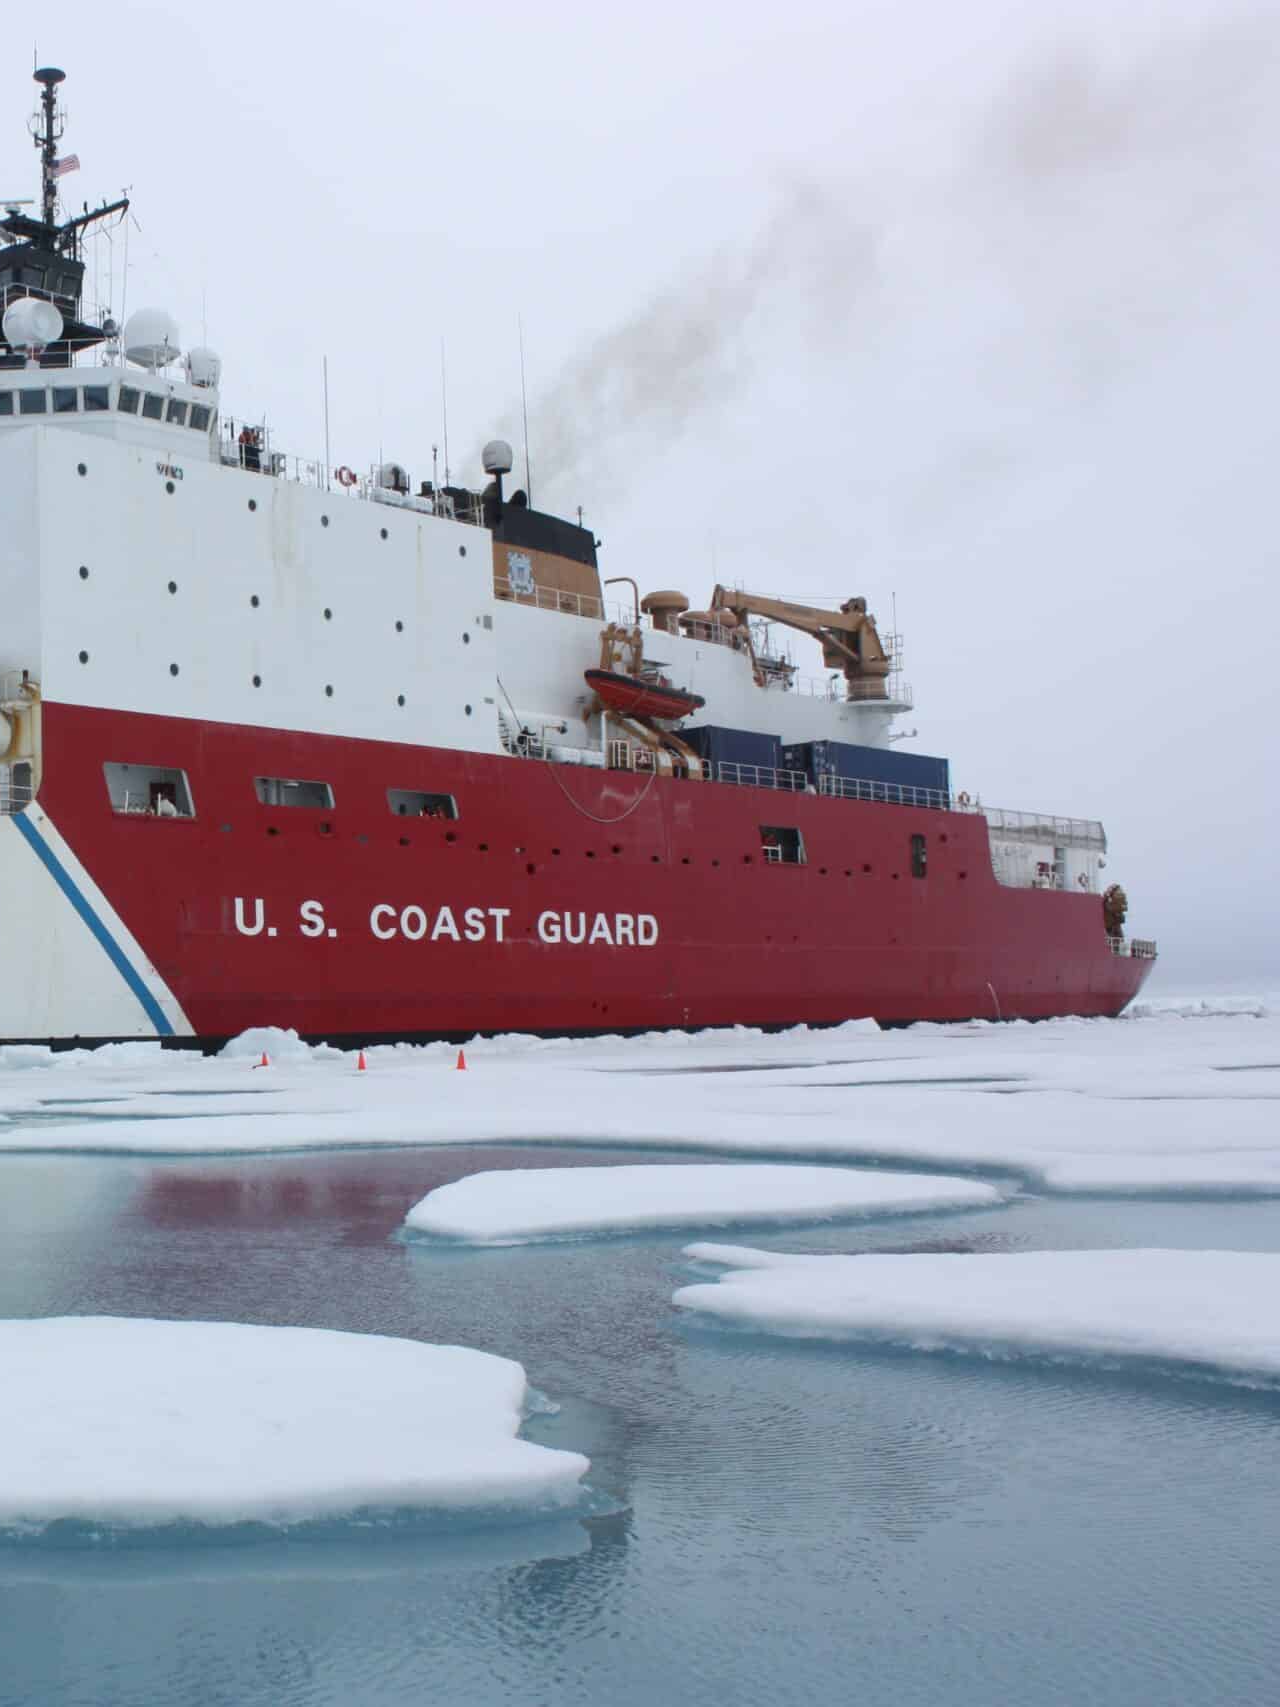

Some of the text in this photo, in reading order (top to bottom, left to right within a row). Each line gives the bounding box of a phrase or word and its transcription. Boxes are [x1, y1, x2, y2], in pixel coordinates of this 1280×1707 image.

[234, 897, 659, 946] U. S. COAST GUARD
